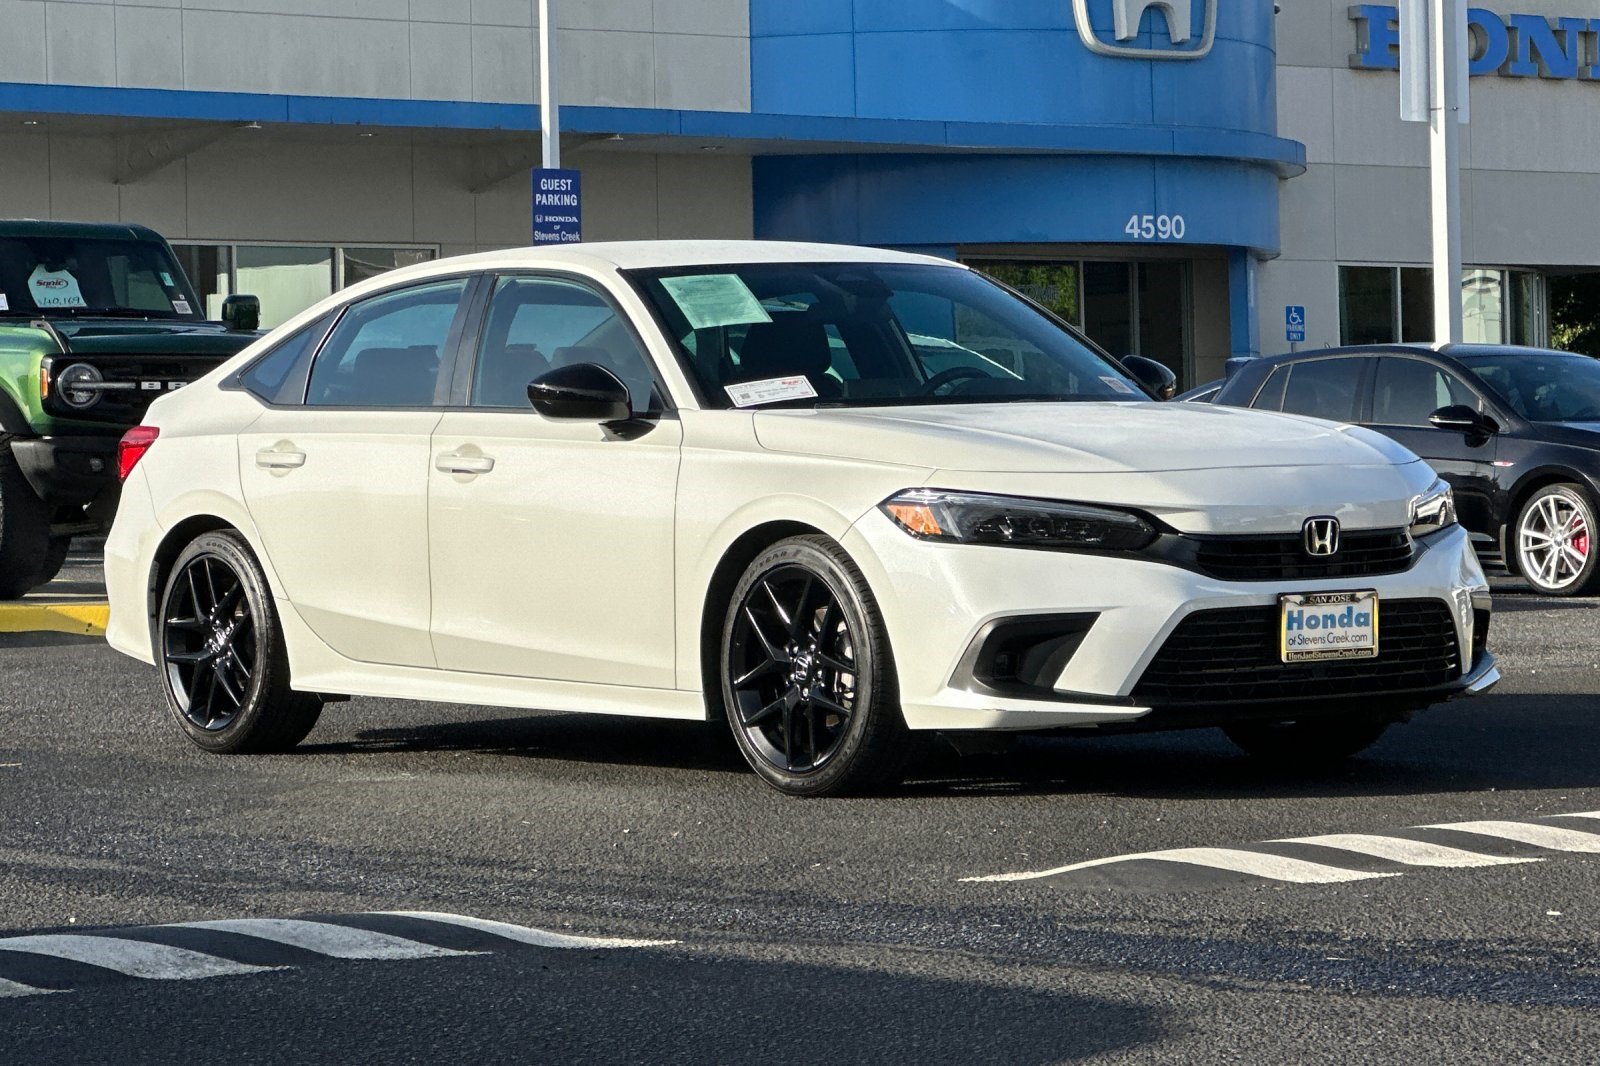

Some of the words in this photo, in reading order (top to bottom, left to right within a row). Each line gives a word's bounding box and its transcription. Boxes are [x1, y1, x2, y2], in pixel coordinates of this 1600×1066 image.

[540, 178, 573, 191] GUEST
[535, 193, 578, 206] PARKING
[544, 215, 579, 223] HONDA
[1125, 214, 1186, 239] 4590
[534, 230, 560, 241] Stevens
[560, 231, 581, 241] Creek
[1309, 595, 1327, 604] SAN
[1328, 594, 1352, 603] JOSE
[1287, 606, 1370, 631] Honda
[1288, 635, 1297, 646] of
